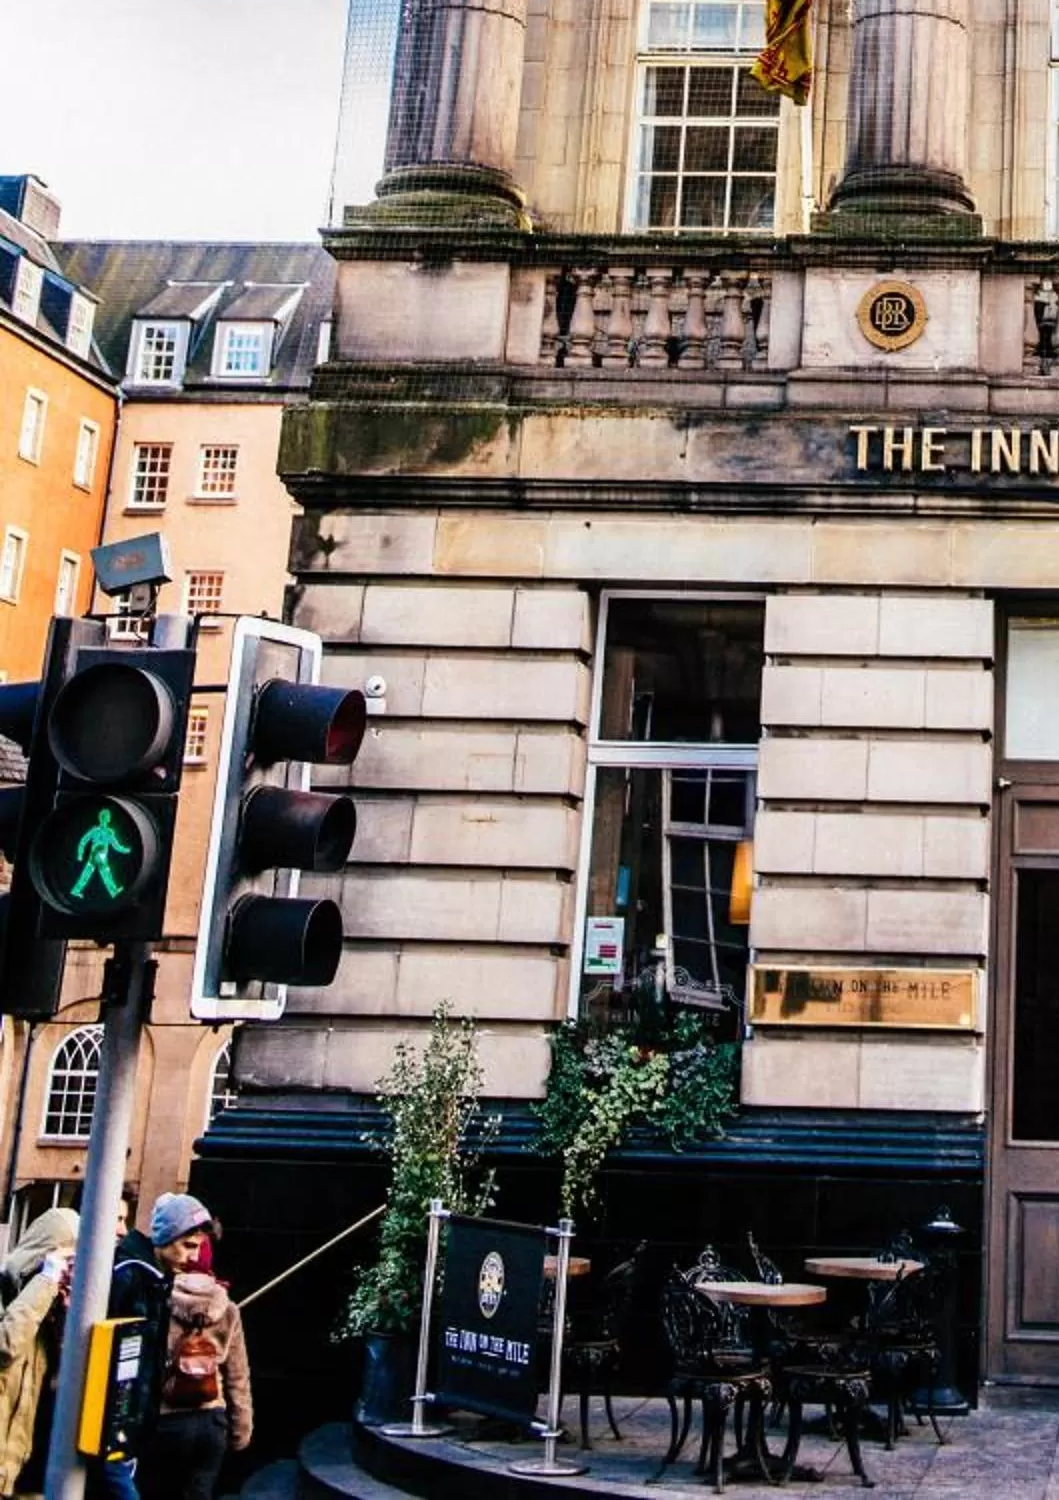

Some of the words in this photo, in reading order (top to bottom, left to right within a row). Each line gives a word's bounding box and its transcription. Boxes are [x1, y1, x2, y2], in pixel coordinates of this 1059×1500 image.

[849, 425, 948, 472] THE
[970, 428, 1059, 474] INN
[907, 980, 952, 1001] MILE
